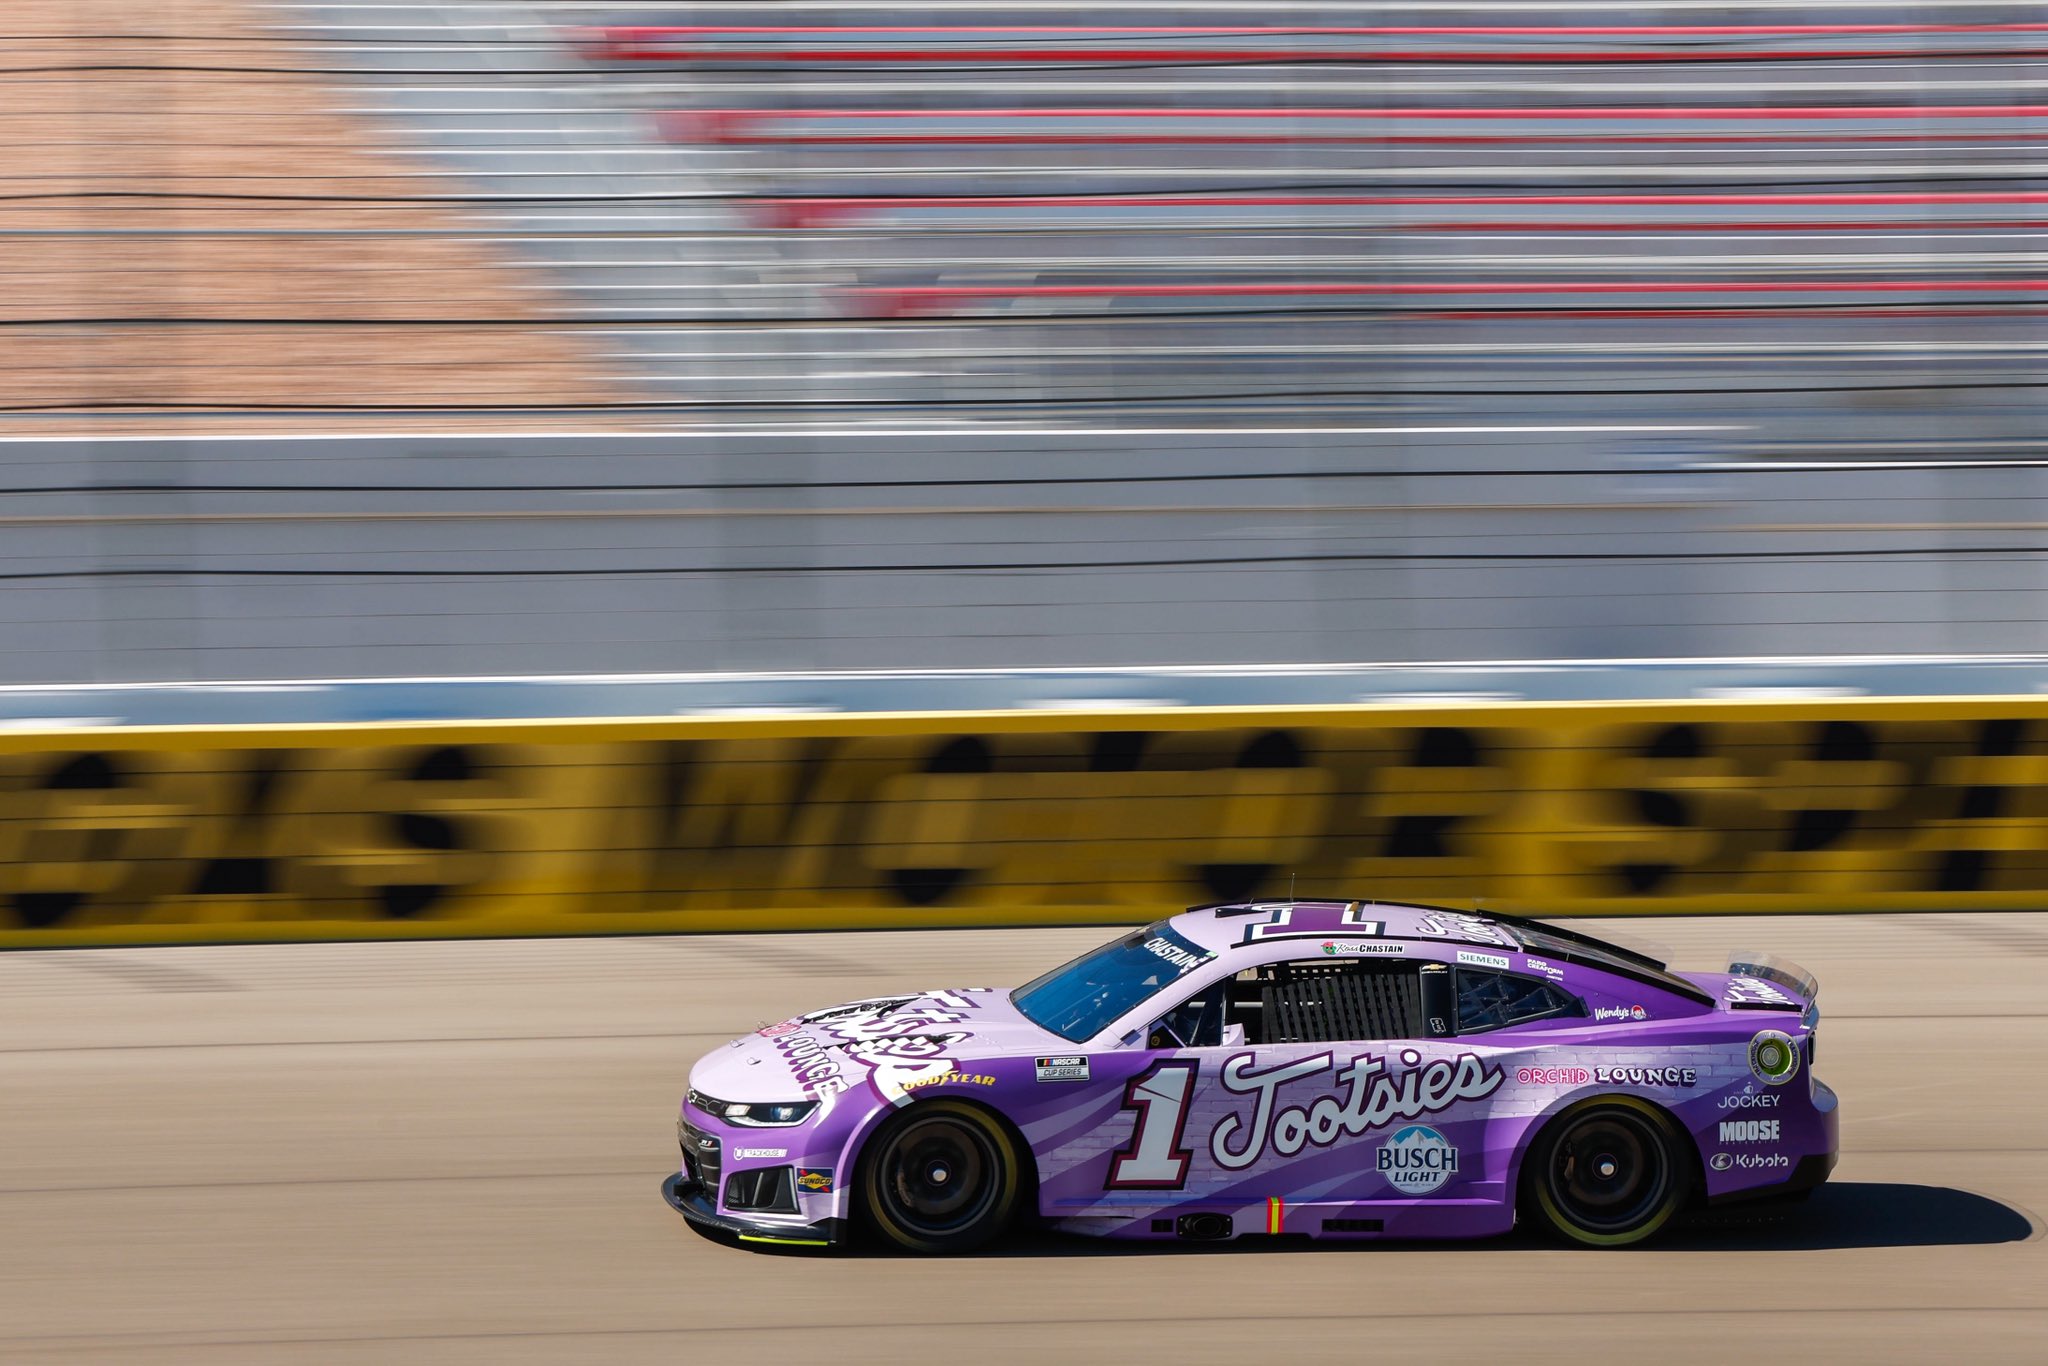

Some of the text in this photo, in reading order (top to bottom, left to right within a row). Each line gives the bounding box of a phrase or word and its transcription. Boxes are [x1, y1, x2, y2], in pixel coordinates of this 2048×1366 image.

[1244, 903, 1386, 939] 1
[1359, 943, 1404, 954] CHASTAIN
[1459, 952, 1507, 967] SIEMENS
[1594, 1005, 1630, 1021] Wendy's
[1053, 1057, 1081, 1066] NASCAR
[1043, 1068, 1082, 1077] CUP SERIES
[1516, 1066, 1697, 1088] ORCHID LOUNGE
[893, 1069, 997, 1096] GOODYEAR
[1717, 1094, 1780, 1109] JOCKEY
[1209, 1049, 1507, 1171] Tootsies
[1102, 1058, 1201, 1191] 1
[1719, 1119, 1780, 1142] MOOSE
[1376, 1147, 1457, 1172] BUSCH
[1735, 1153, 1789, 1168] Kubota
[797, 1177, 832, 1186] SUNOCO
[1394, 1171, 1441, 1183] LIGHT
